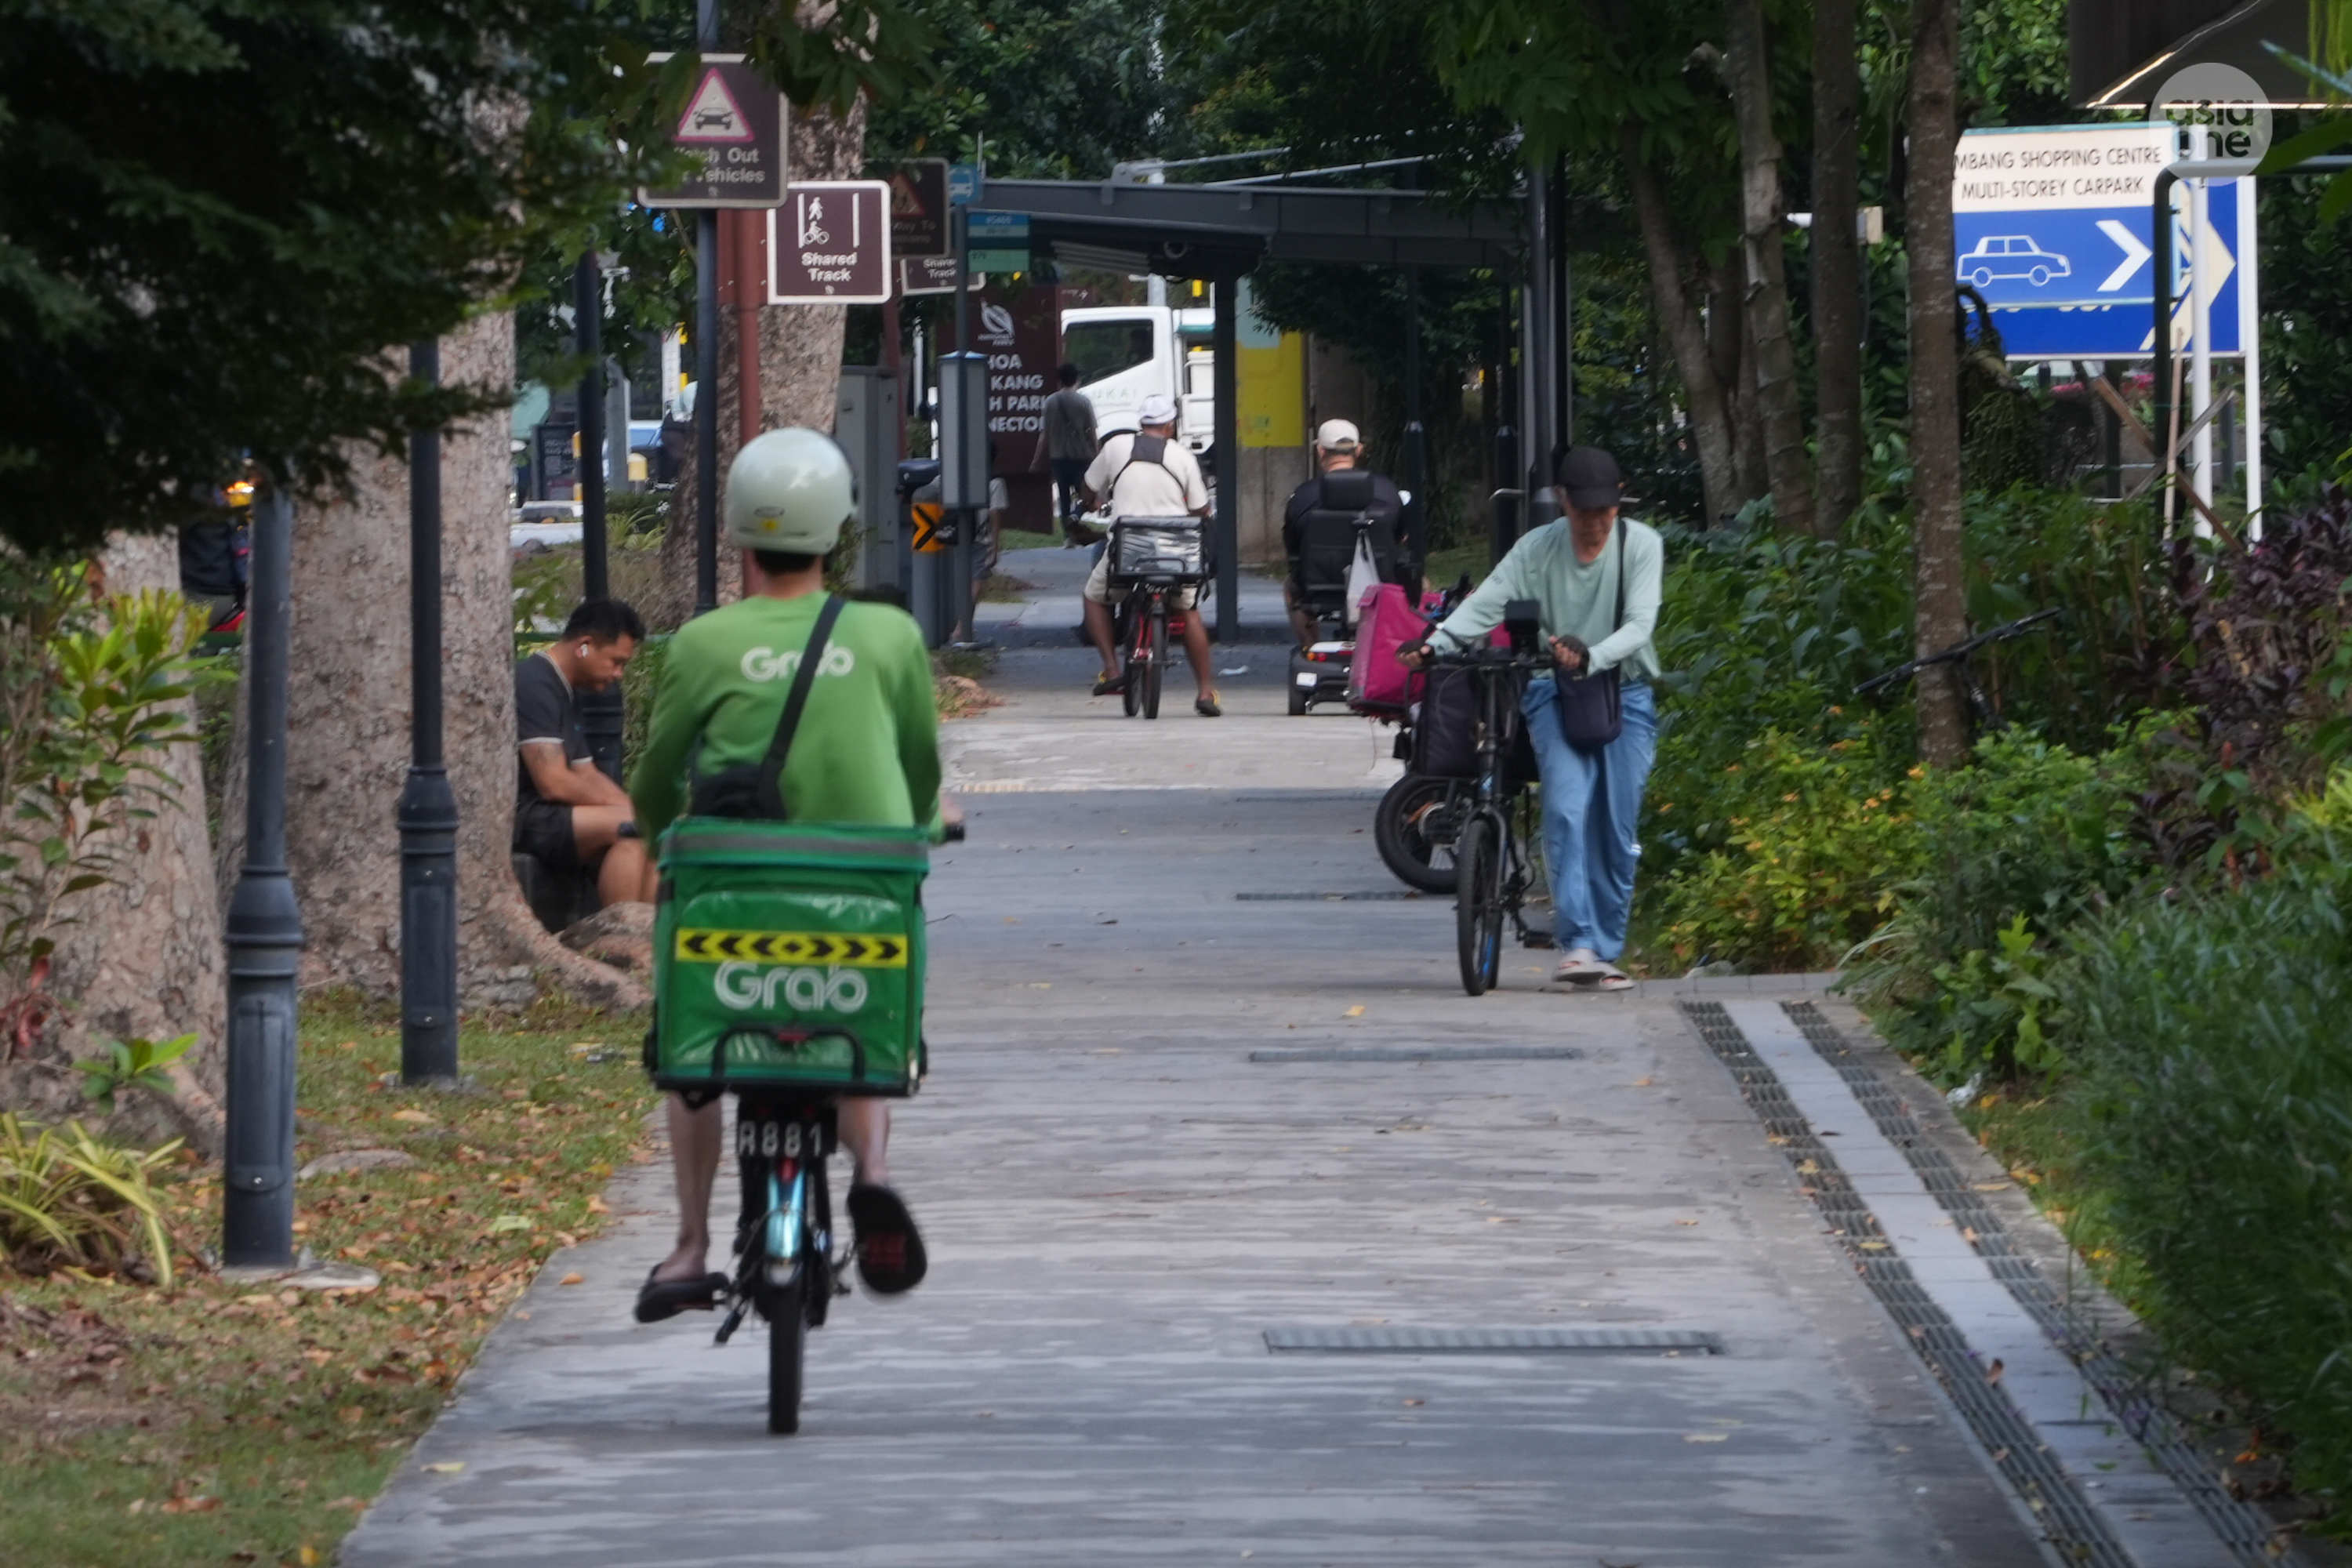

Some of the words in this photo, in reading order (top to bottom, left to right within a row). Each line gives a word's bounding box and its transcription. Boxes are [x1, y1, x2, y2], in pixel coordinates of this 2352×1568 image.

[727, 147, 760, 164] Out
[1954, 151, 2014, 170] MBANG
[2020, 148, 2101, 169] SHOPPING
[2106, 147, 2162, 165] CENTRE
[695, 166, 766, 184] ehicles
[1962, 179, 2068, 199] MULTI-STOREY
[2074, 176, 2145, 195] CARPARK
[801, 252, 858, 267] Shared
[923, 259, 957, 269] Share
[808, 267, 852, 282] Track
[990, 375, 1044, 390] KANG
[988, 416, 1045, 433] NECTO
[741, 639, 855, 683] Grb
[713, 959, 869, 1014] Grab
